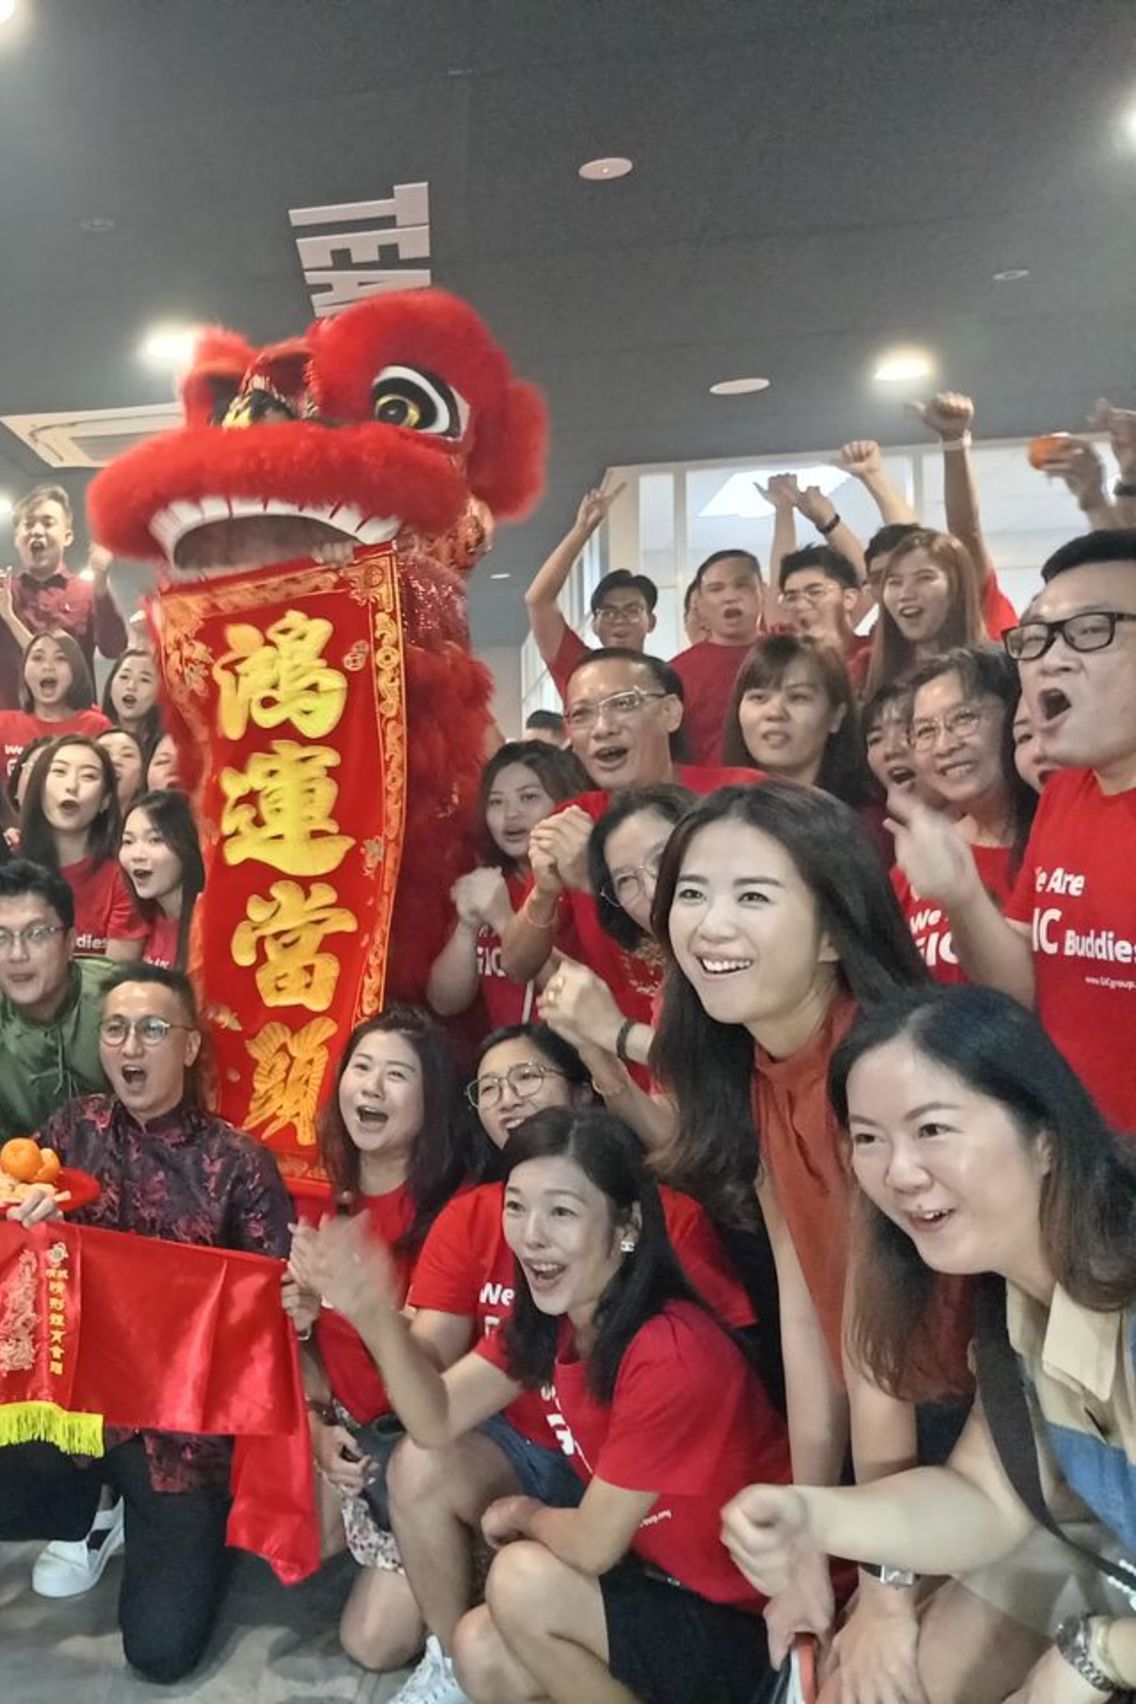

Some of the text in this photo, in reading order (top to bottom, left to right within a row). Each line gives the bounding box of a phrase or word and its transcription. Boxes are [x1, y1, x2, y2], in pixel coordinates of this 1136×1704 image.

[288, 181, 432, 317] TEA
[1045, 867, 1086, 897] Are
[909, 908, 942, 935] We
[1032, 907, 1136, 964] IC Buddie
